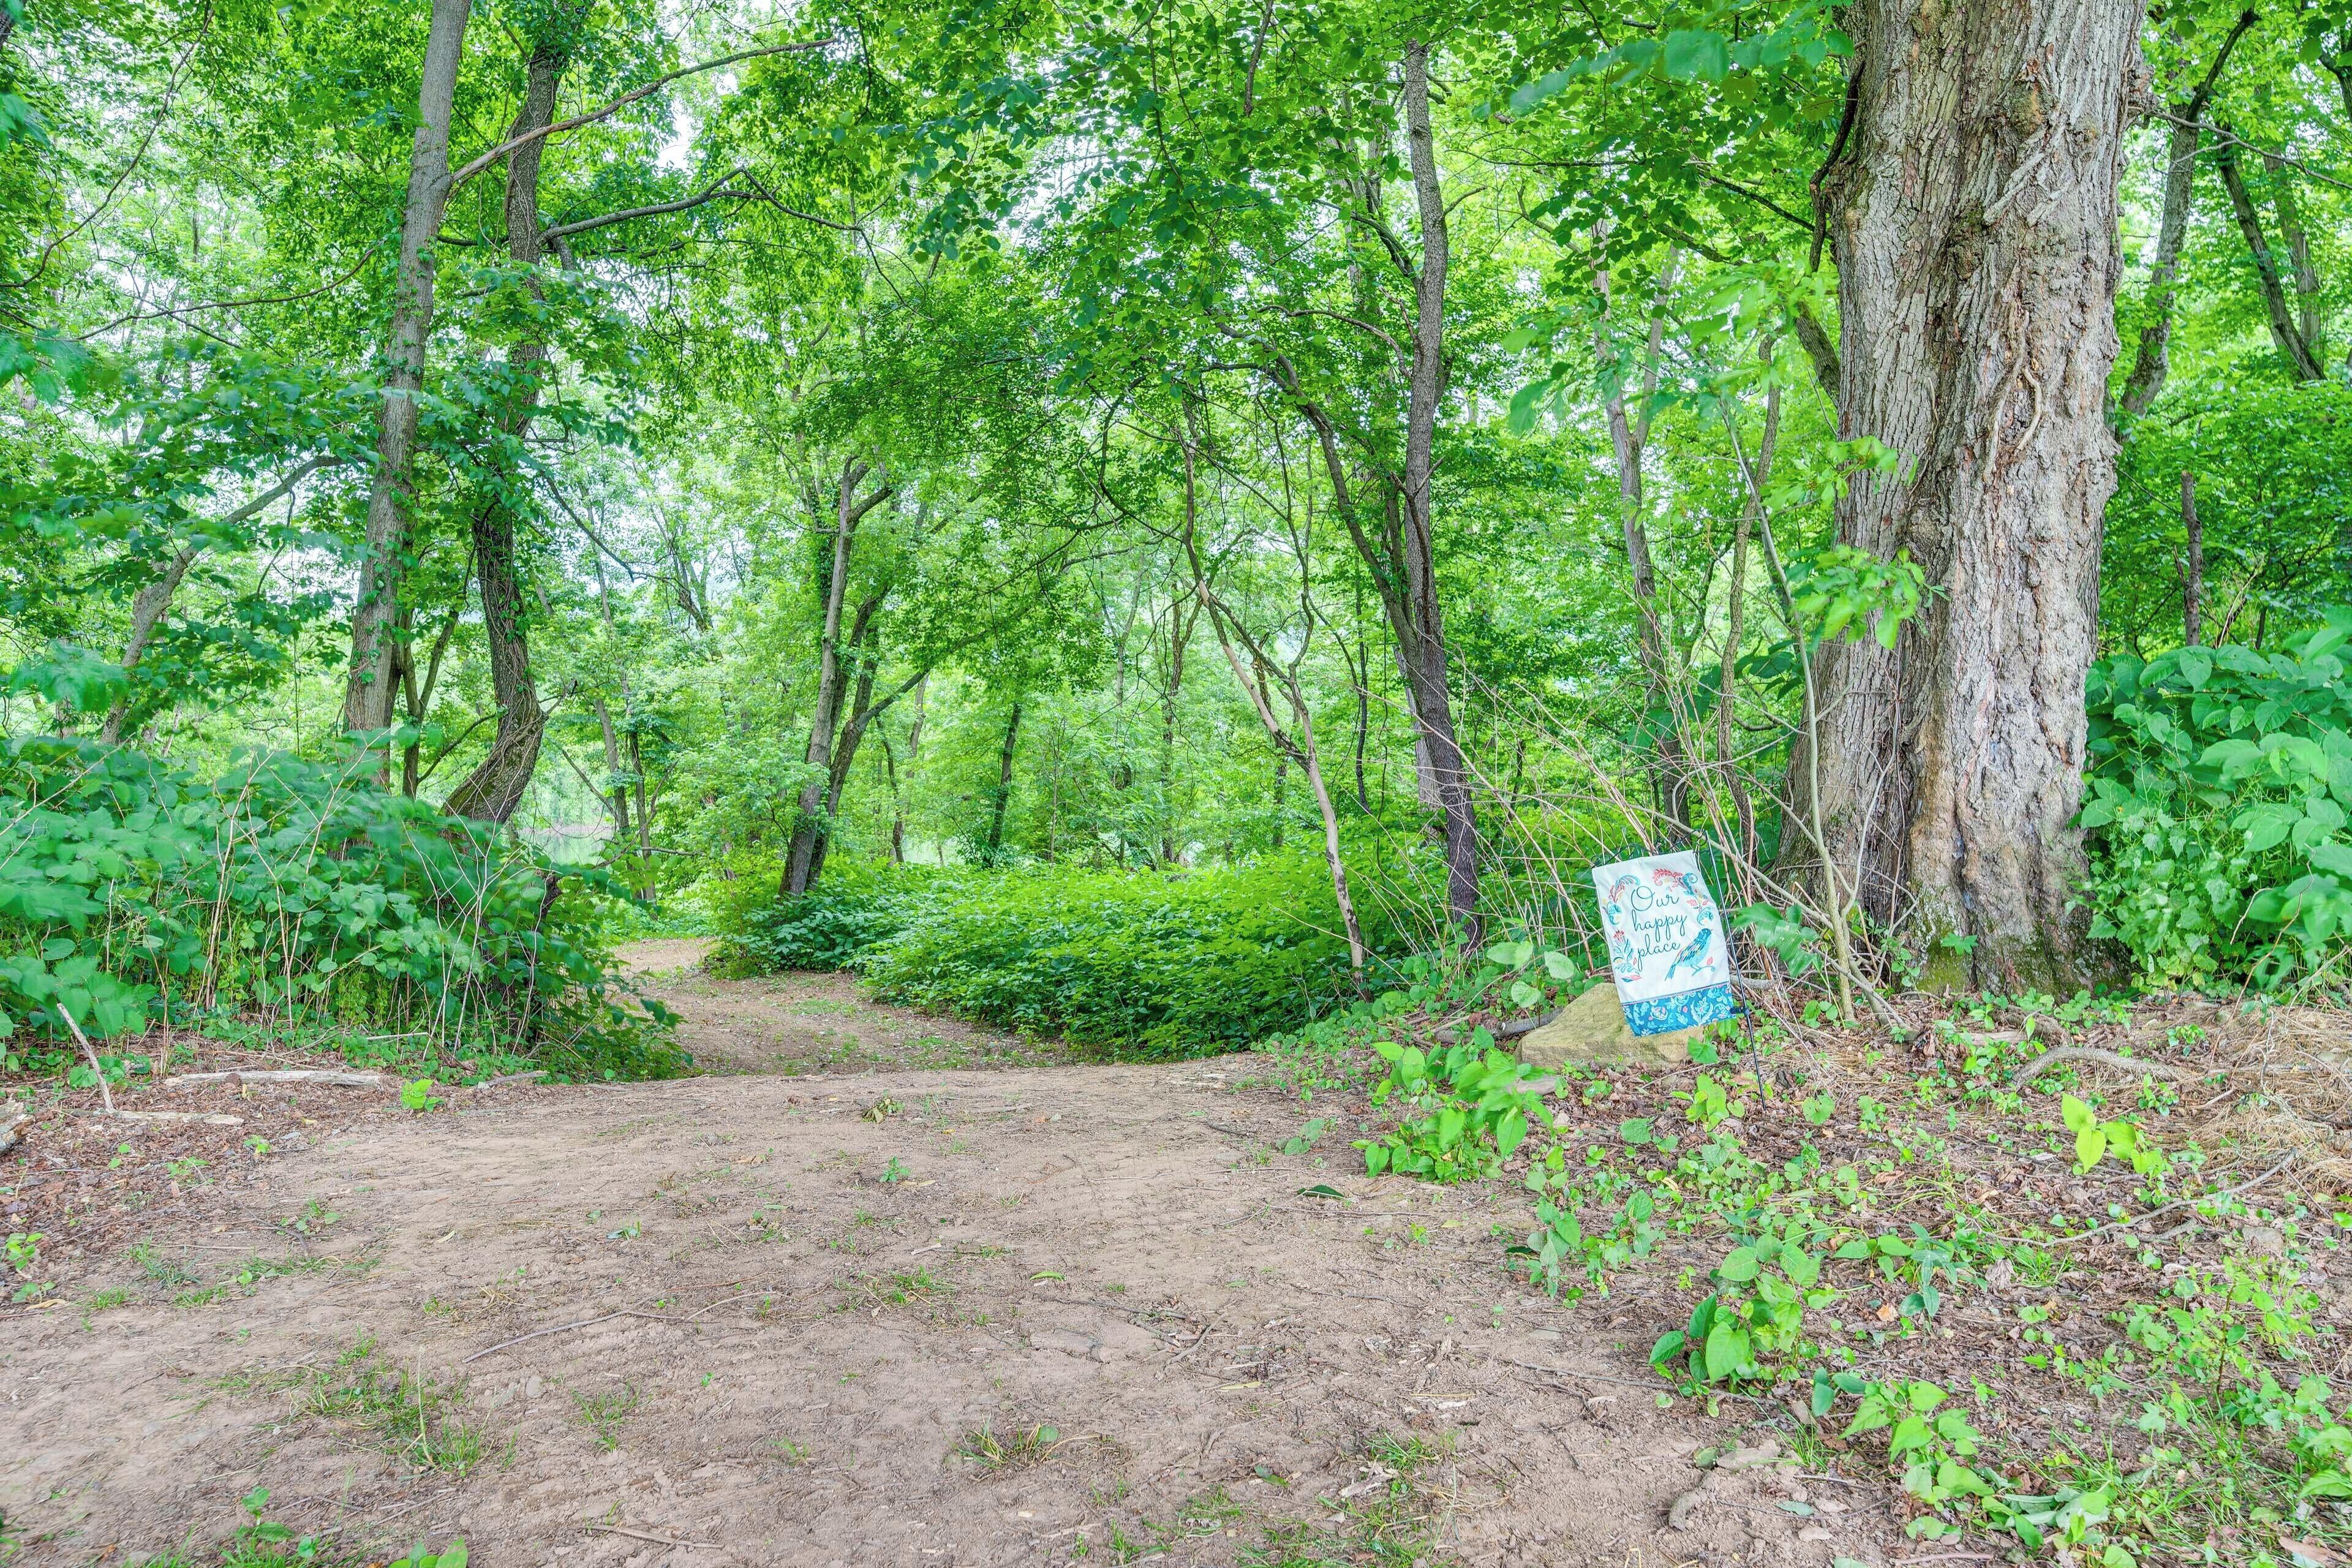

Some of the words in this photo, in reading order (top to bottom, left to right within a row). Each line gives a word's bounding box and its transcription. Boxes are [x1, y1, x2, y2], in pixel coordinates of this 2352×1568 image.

[1630, 886, 1679, 911] Our
[1632, 910, 1687, 943] happy
[1636, 934, 1681, 971] place
